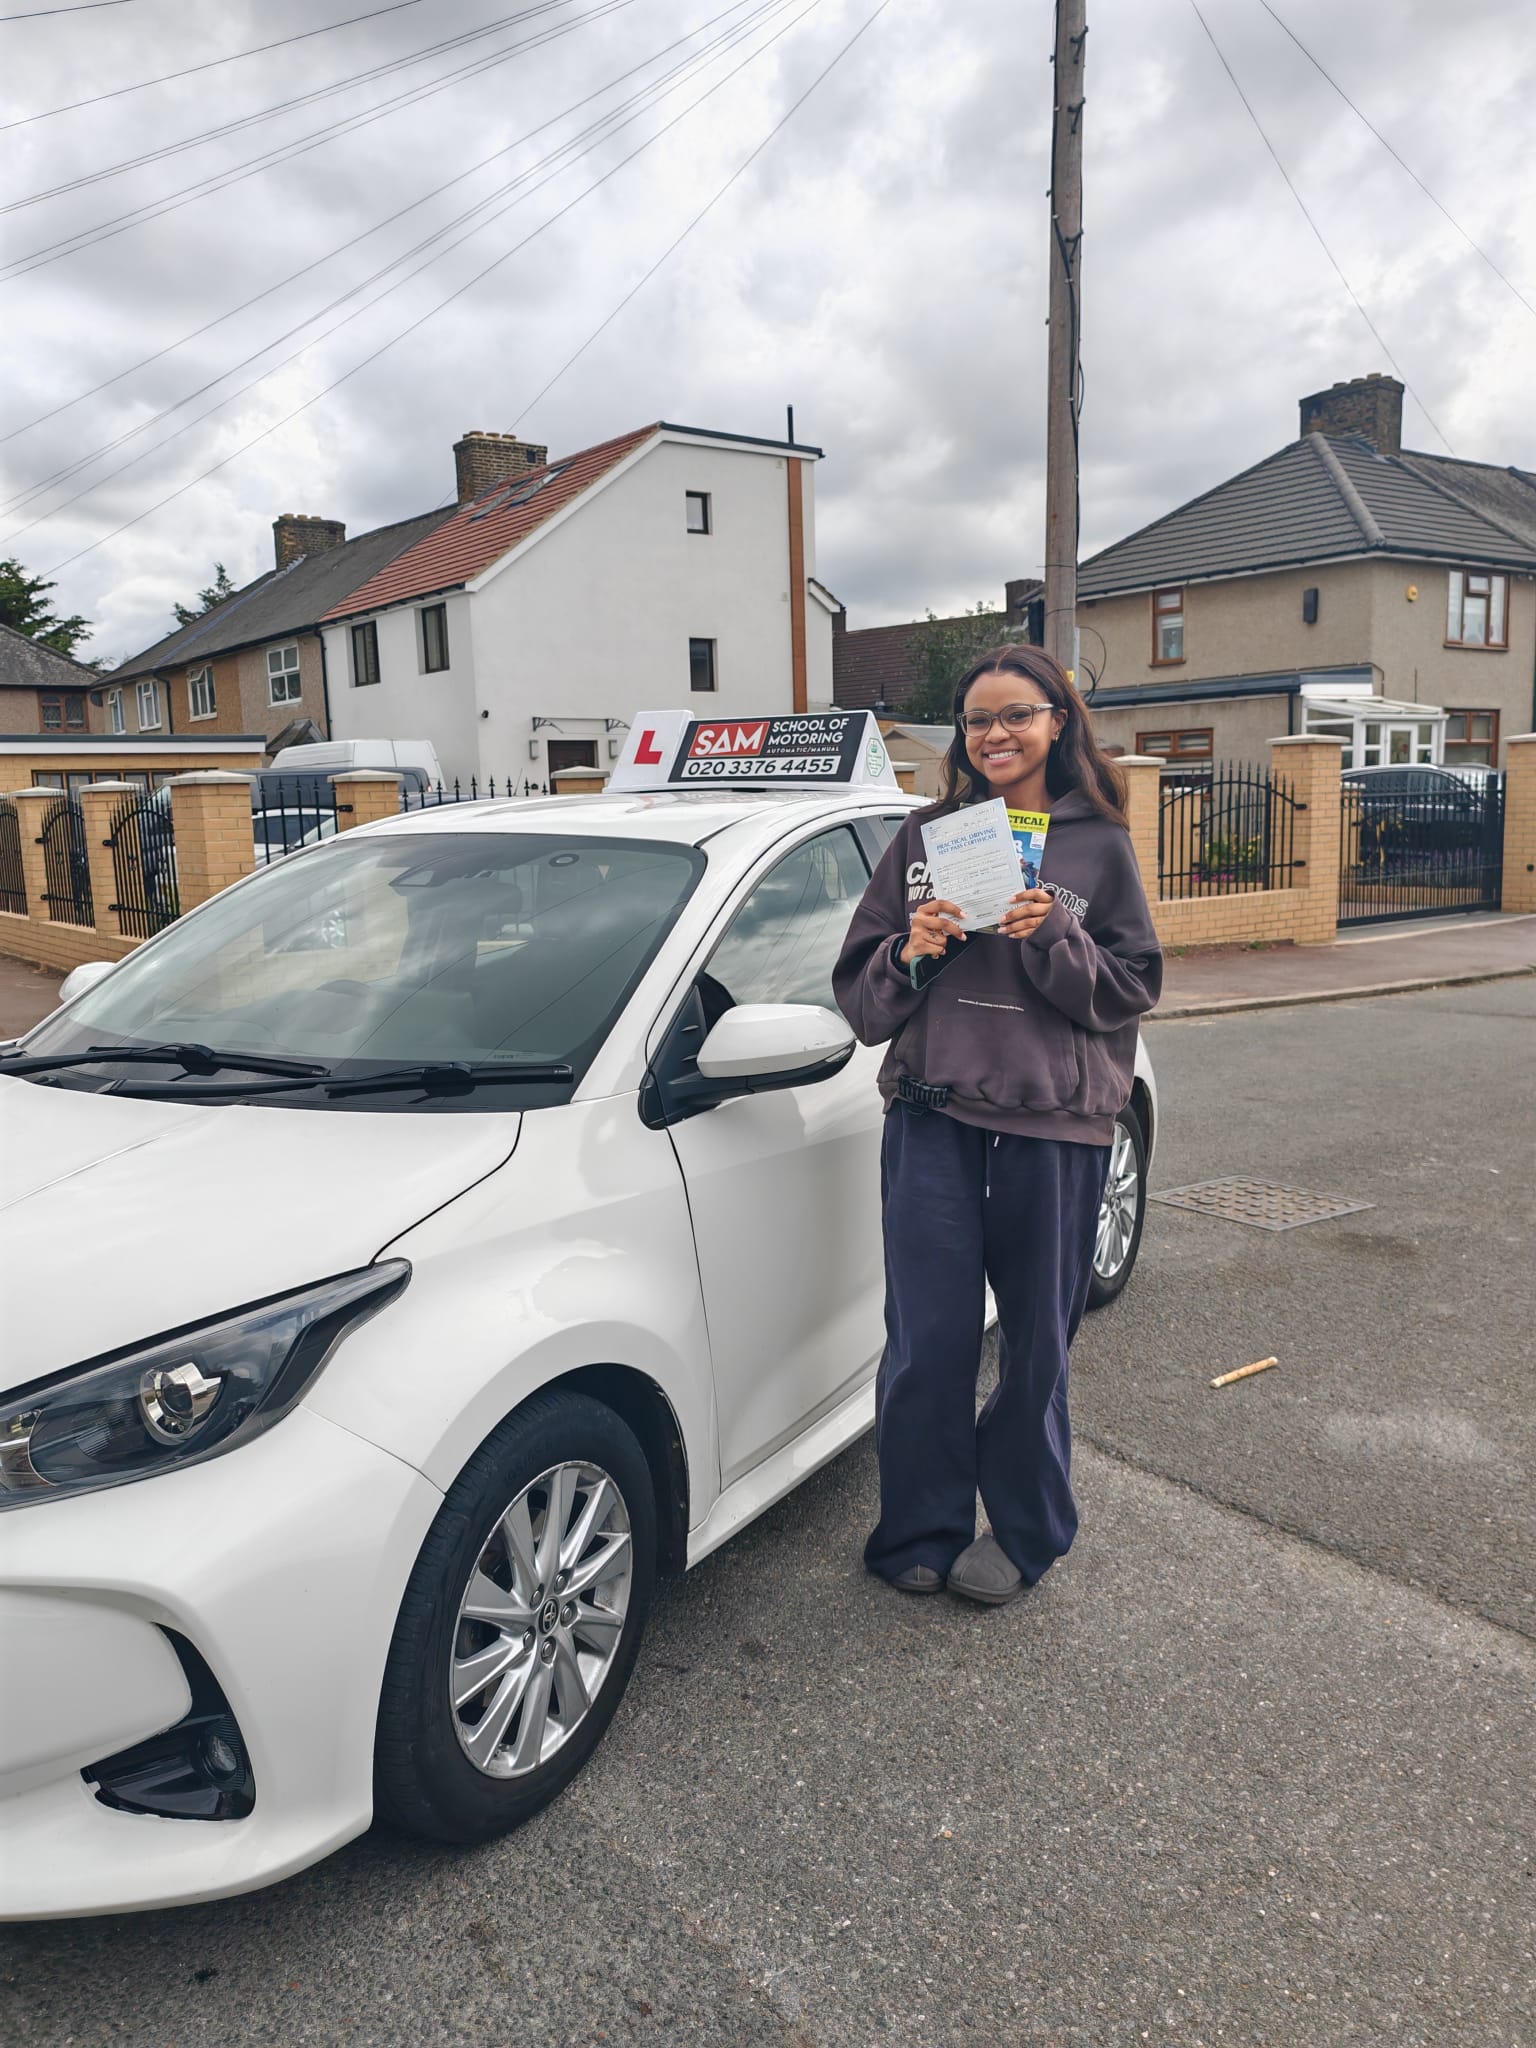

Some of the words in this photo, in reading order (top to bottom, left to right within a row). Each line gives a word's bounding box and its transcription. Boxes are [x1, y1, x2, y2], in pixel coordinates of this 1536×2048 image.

[772, 719, 826, 733] SCHOOL
[829, 717, 850, 730] OF
[633, 730, 663, 764] L
[694, 724, 764, 755] SAM
[768, 731, 844, 746] MOTORING
[688, 761, 726, 775] 020
[728, 760, 777, 775] 3376
[780, 758, 835, 774] 4455
